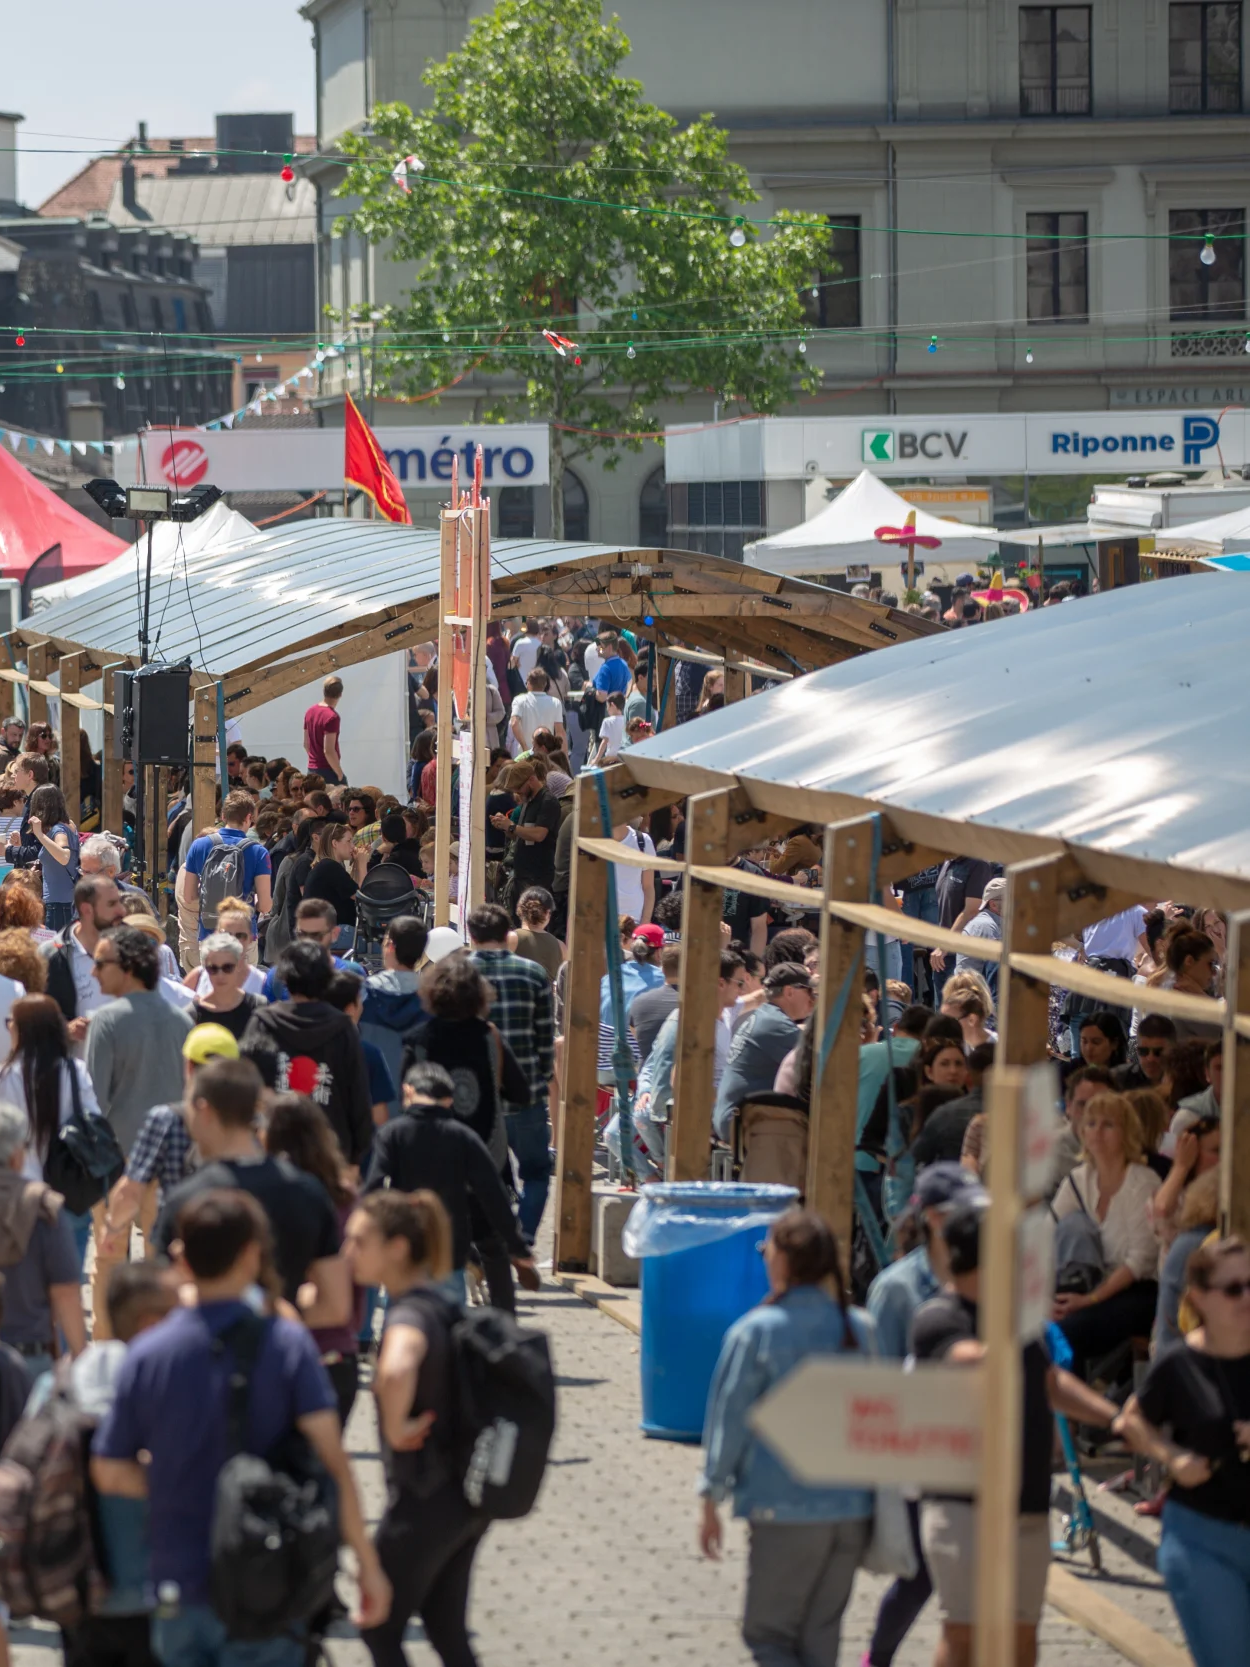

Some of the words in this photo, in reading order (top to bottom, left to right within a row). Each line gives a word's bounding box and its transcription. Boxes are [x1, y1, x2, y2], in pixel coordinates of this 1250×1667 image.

[1134, 388, 1200, 403] ESPACE
[1213, 387, 1250, 402] ARL
[384, 435, 534, 480] métro
[898, 431, 968, 459] BCV
[1051, 431, 1176, 458] Riponne
